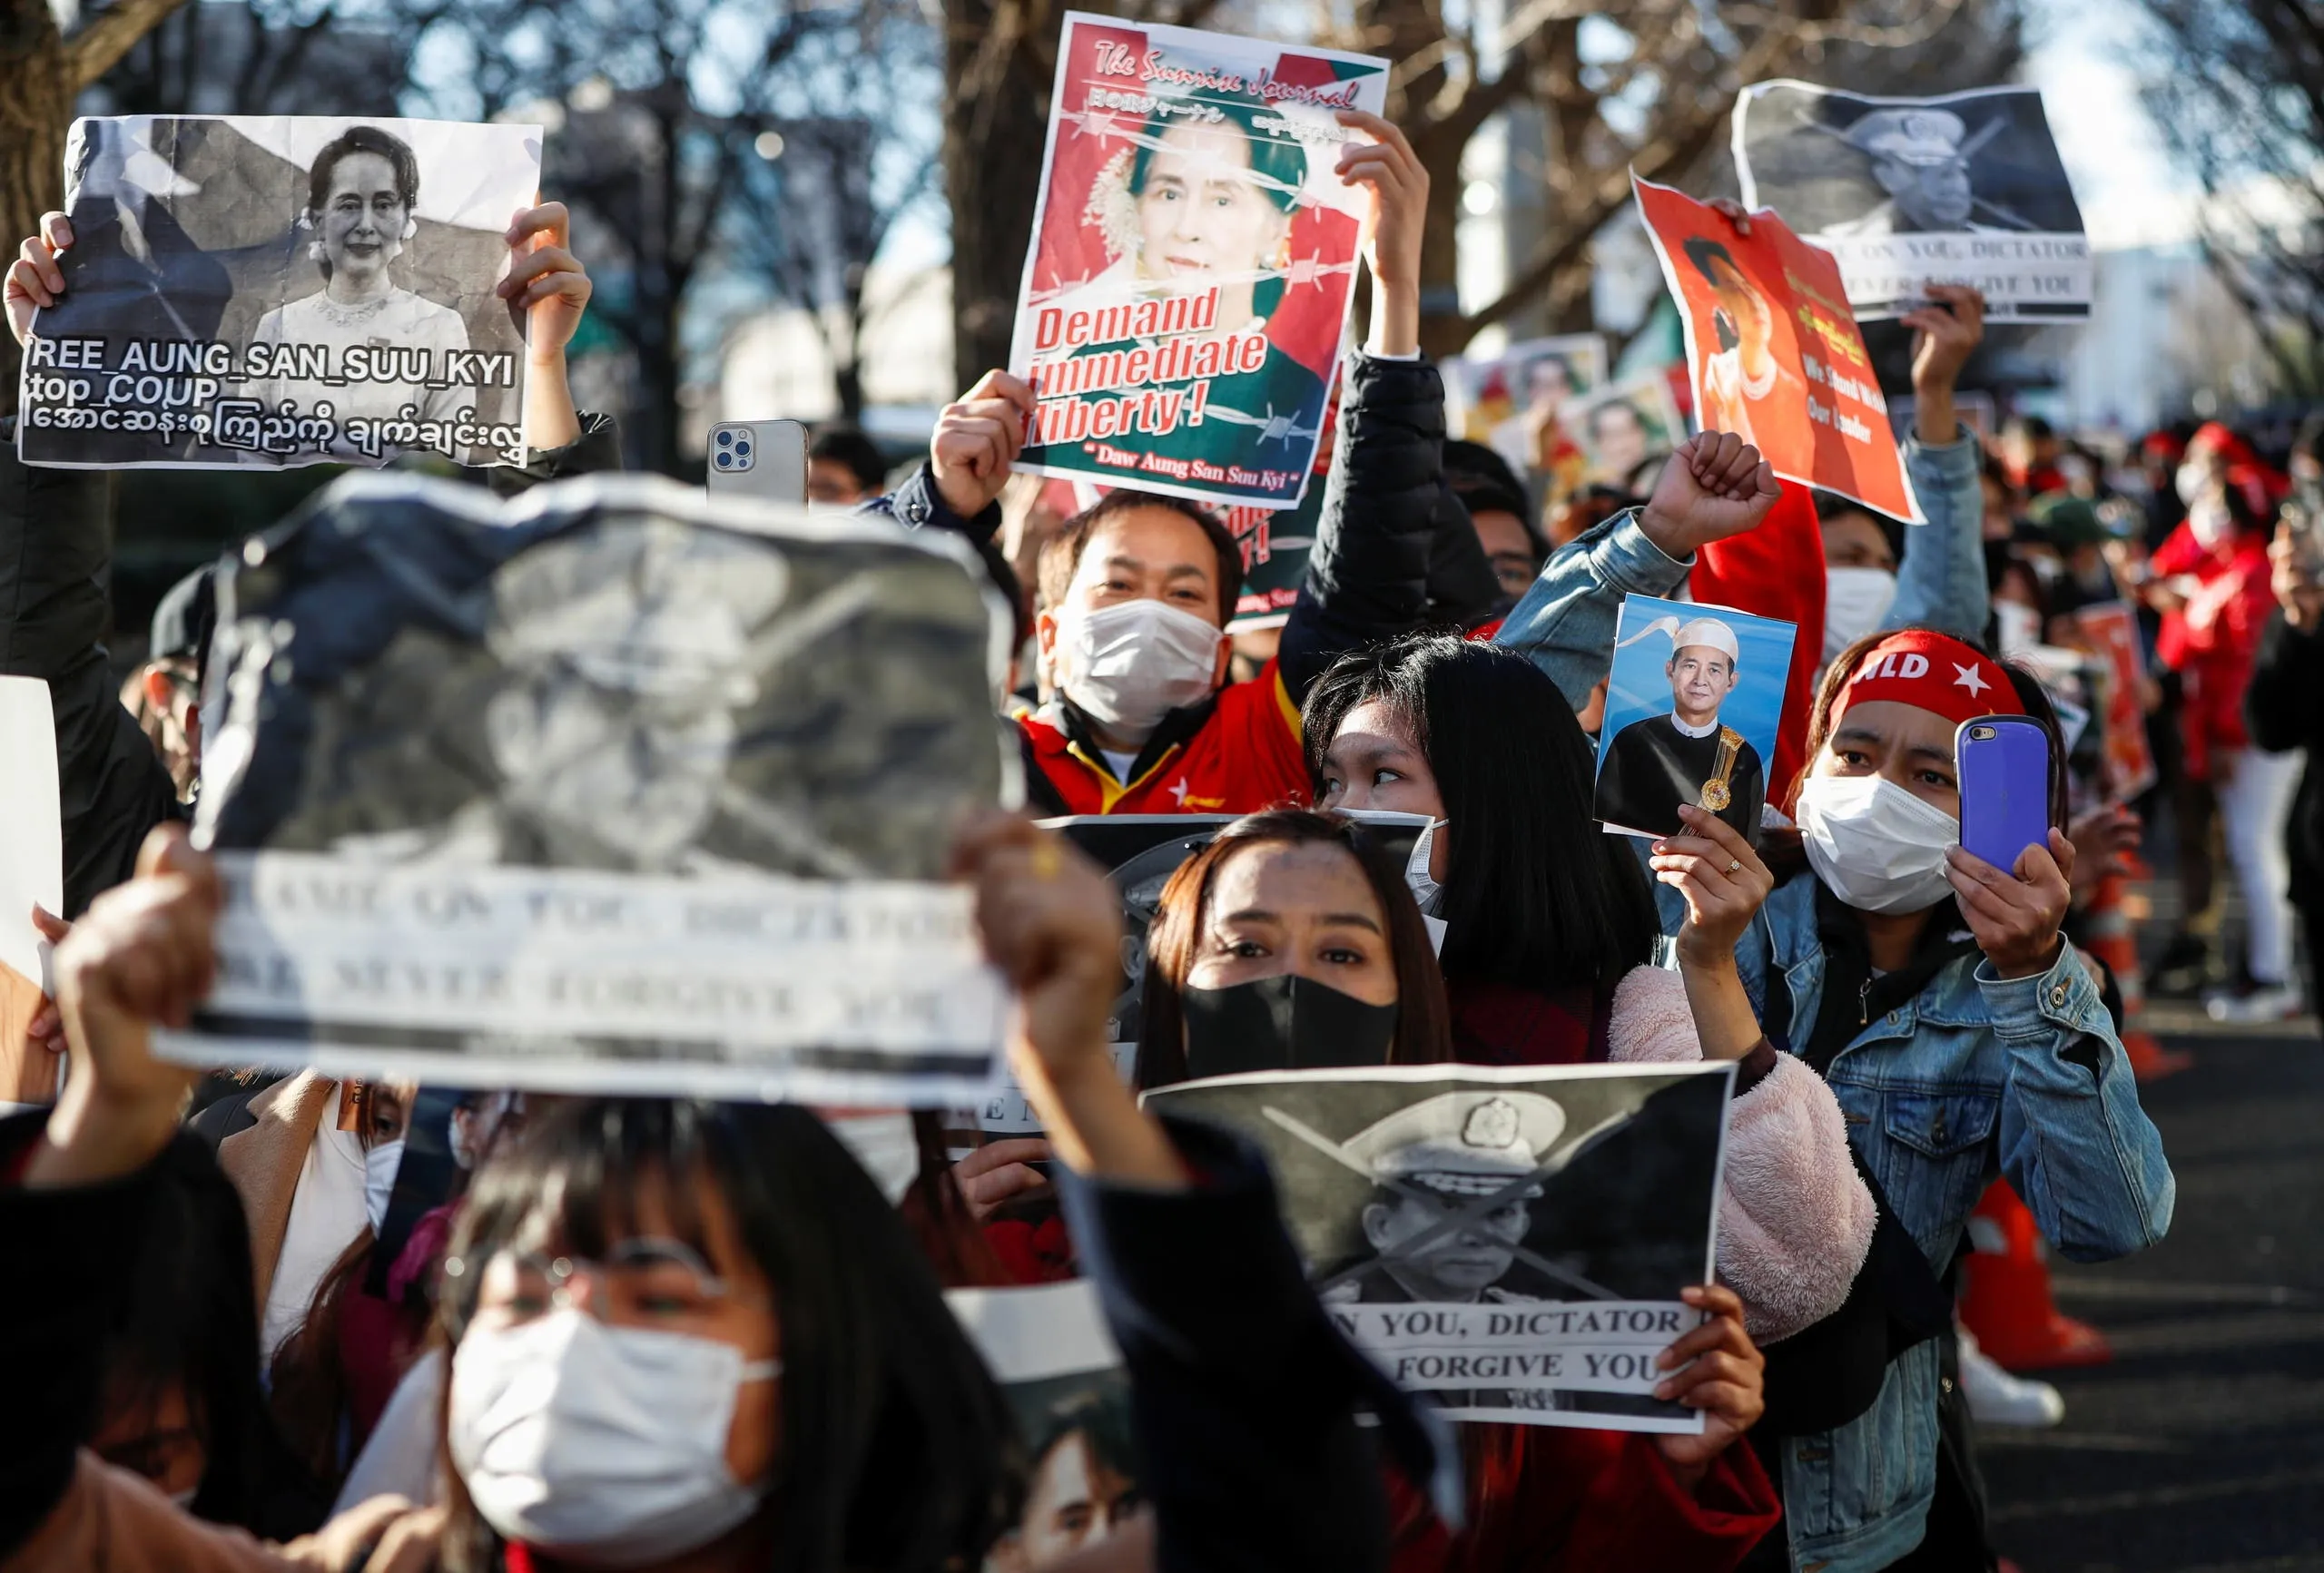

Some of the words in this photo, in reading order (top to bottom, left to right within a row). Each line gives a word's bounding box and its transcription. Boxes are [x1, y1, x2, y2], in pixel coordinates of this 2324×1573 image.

[1095, 39, 1135, 75] The
[1139, 49, 1242, 93] Sunrise
[1247, 66, 1359, 110] Journal
[1034, 286, 1220, 350] Demand
[1027, 334, 1267, 398] immediate
[1803, 353, 1825, 382] We
[1826, 365, 1861, 401] Stand
[1807, 395, 1829, 425] Our
[1833, 405, 1872, 444] Leader
[1138, 452, 1188, 479] Aung
[1191, 459, 1224, 481] San
[1227, 465, 1257, 486] Suu
[1334, 1312, 1360, 1338] N
[1380, 1312, 1468, 1339] YOU,
[1487, 1310, 1681, 1337] DICTATOR
[1396, 1353, 1562, 1382] FORGIVE
[1582, 1352, 1660, 1382] YOU
